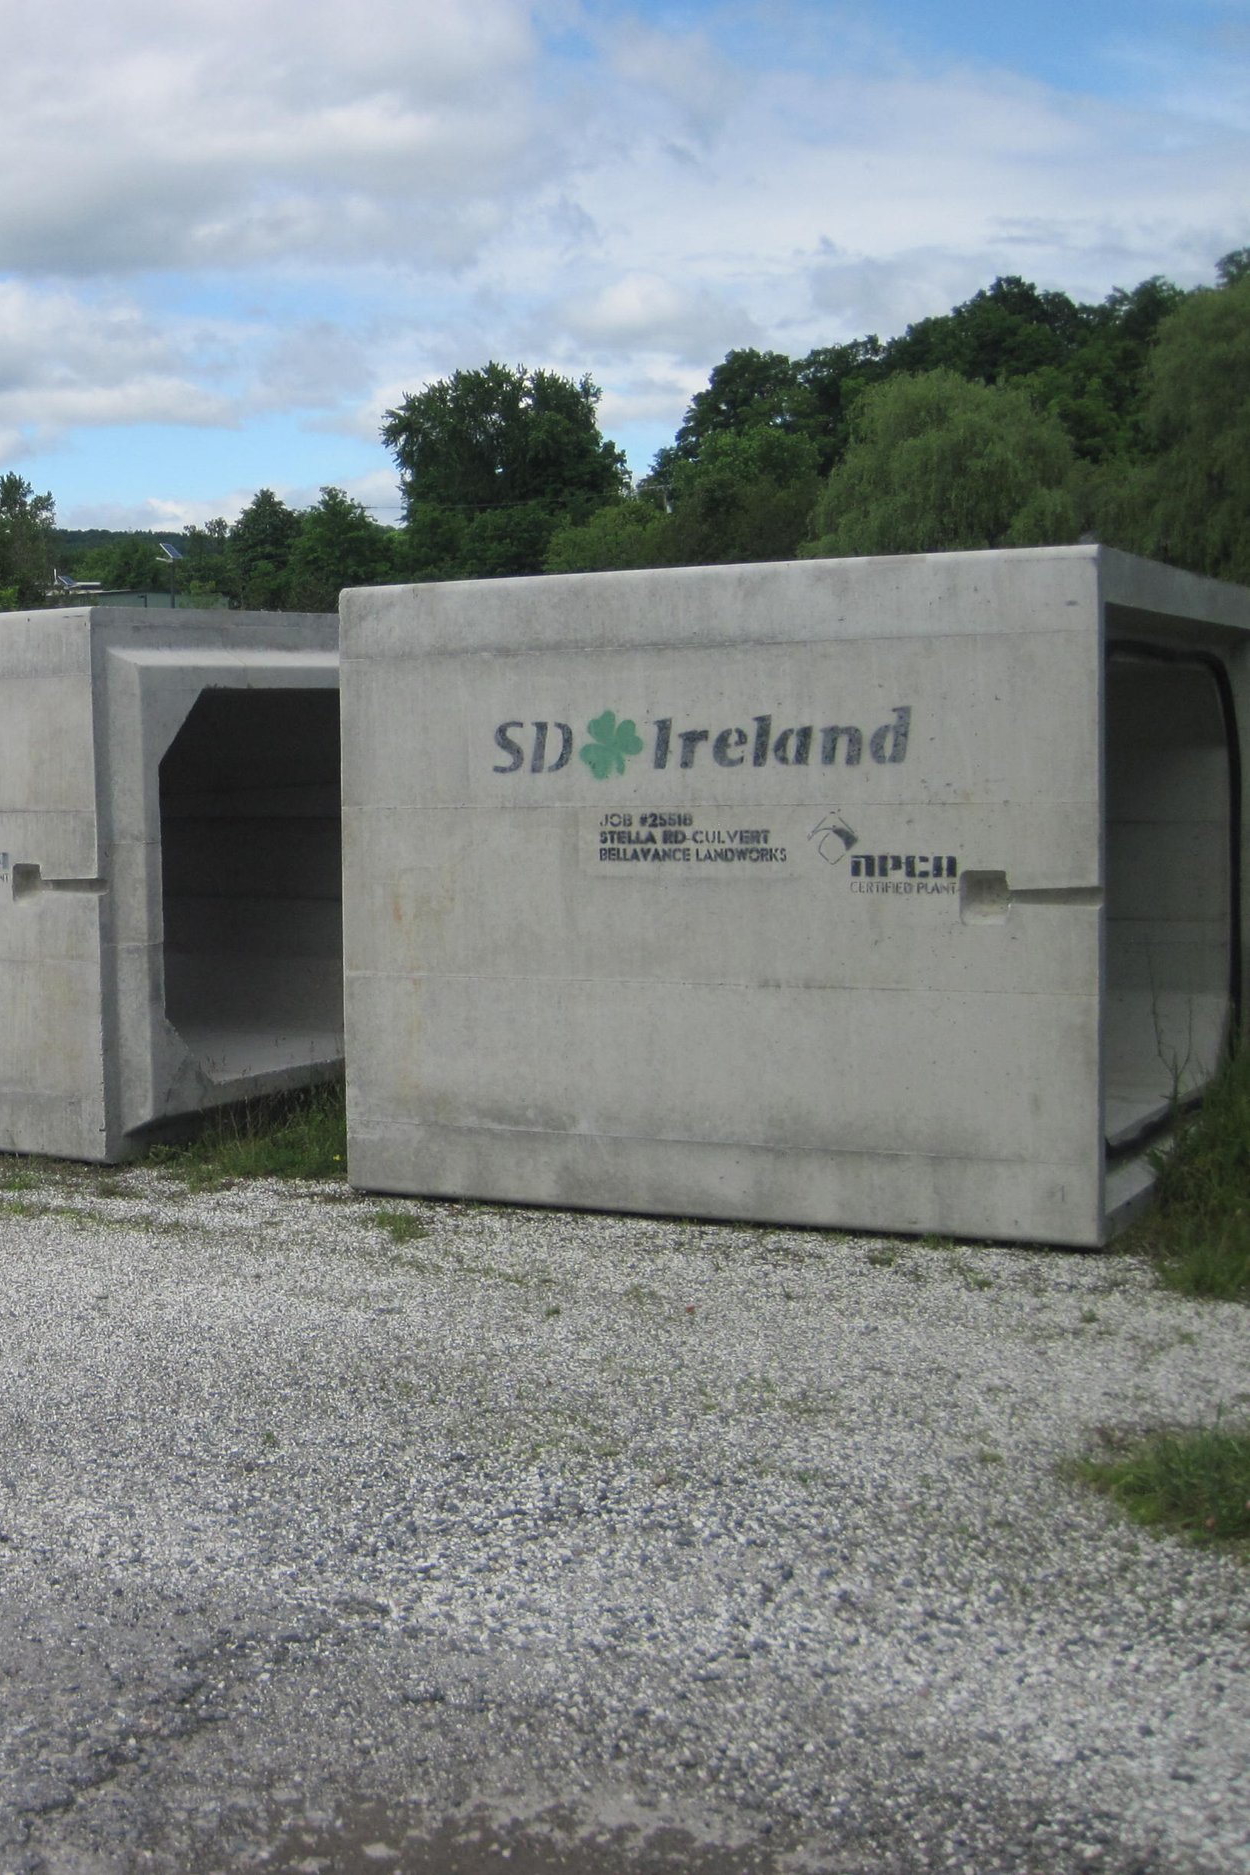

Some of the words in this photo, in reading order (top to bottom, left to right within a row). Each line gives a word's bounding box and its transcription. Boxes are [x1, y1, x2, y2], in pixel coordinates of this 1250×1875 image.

[492, 721, 573, 774] SD
[653, 705, 912, 770] Ireland
[600, 812, 632, 827] JOB
[600, 829, 657, 845] STELLA
[600, 848, 691, 862] BELLAVANCE
[696, 848, 787, 863] LANDWORKS
[850, 882, 913, 894] CERTIFIED
[917, 882, 956, 894] PLANT
